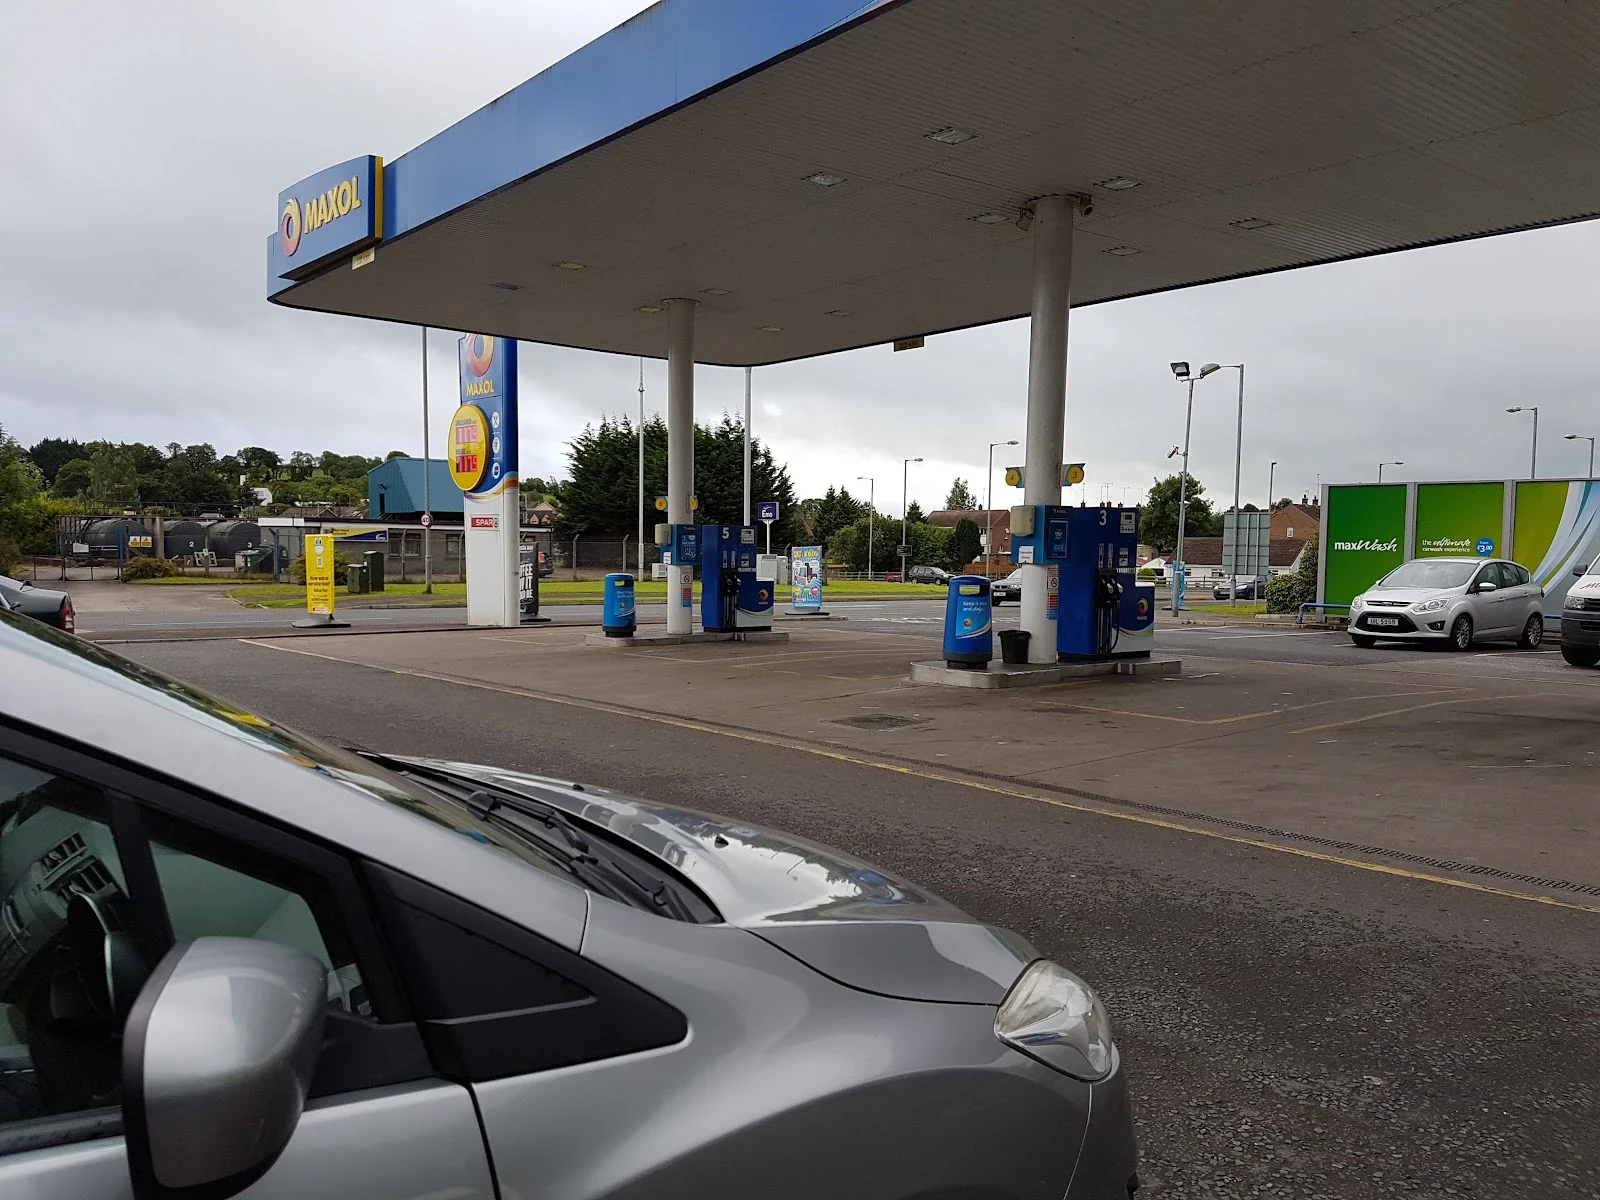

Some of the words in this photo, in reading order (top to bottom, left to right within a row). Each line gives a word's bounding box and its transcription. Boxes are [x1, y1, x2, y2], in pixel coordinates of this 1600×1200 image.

[303, 175, 362, 234] MAXOL
[466, 379, 495, 397] MAXOL
[761, 509, 773, 518] Emo
[1098, 509, 1108, 526] 3
[475, 518, 494, 527] SPAR
[721, 526, 730, 540] 5
[1432, 537, 1471, 547] ultimate
